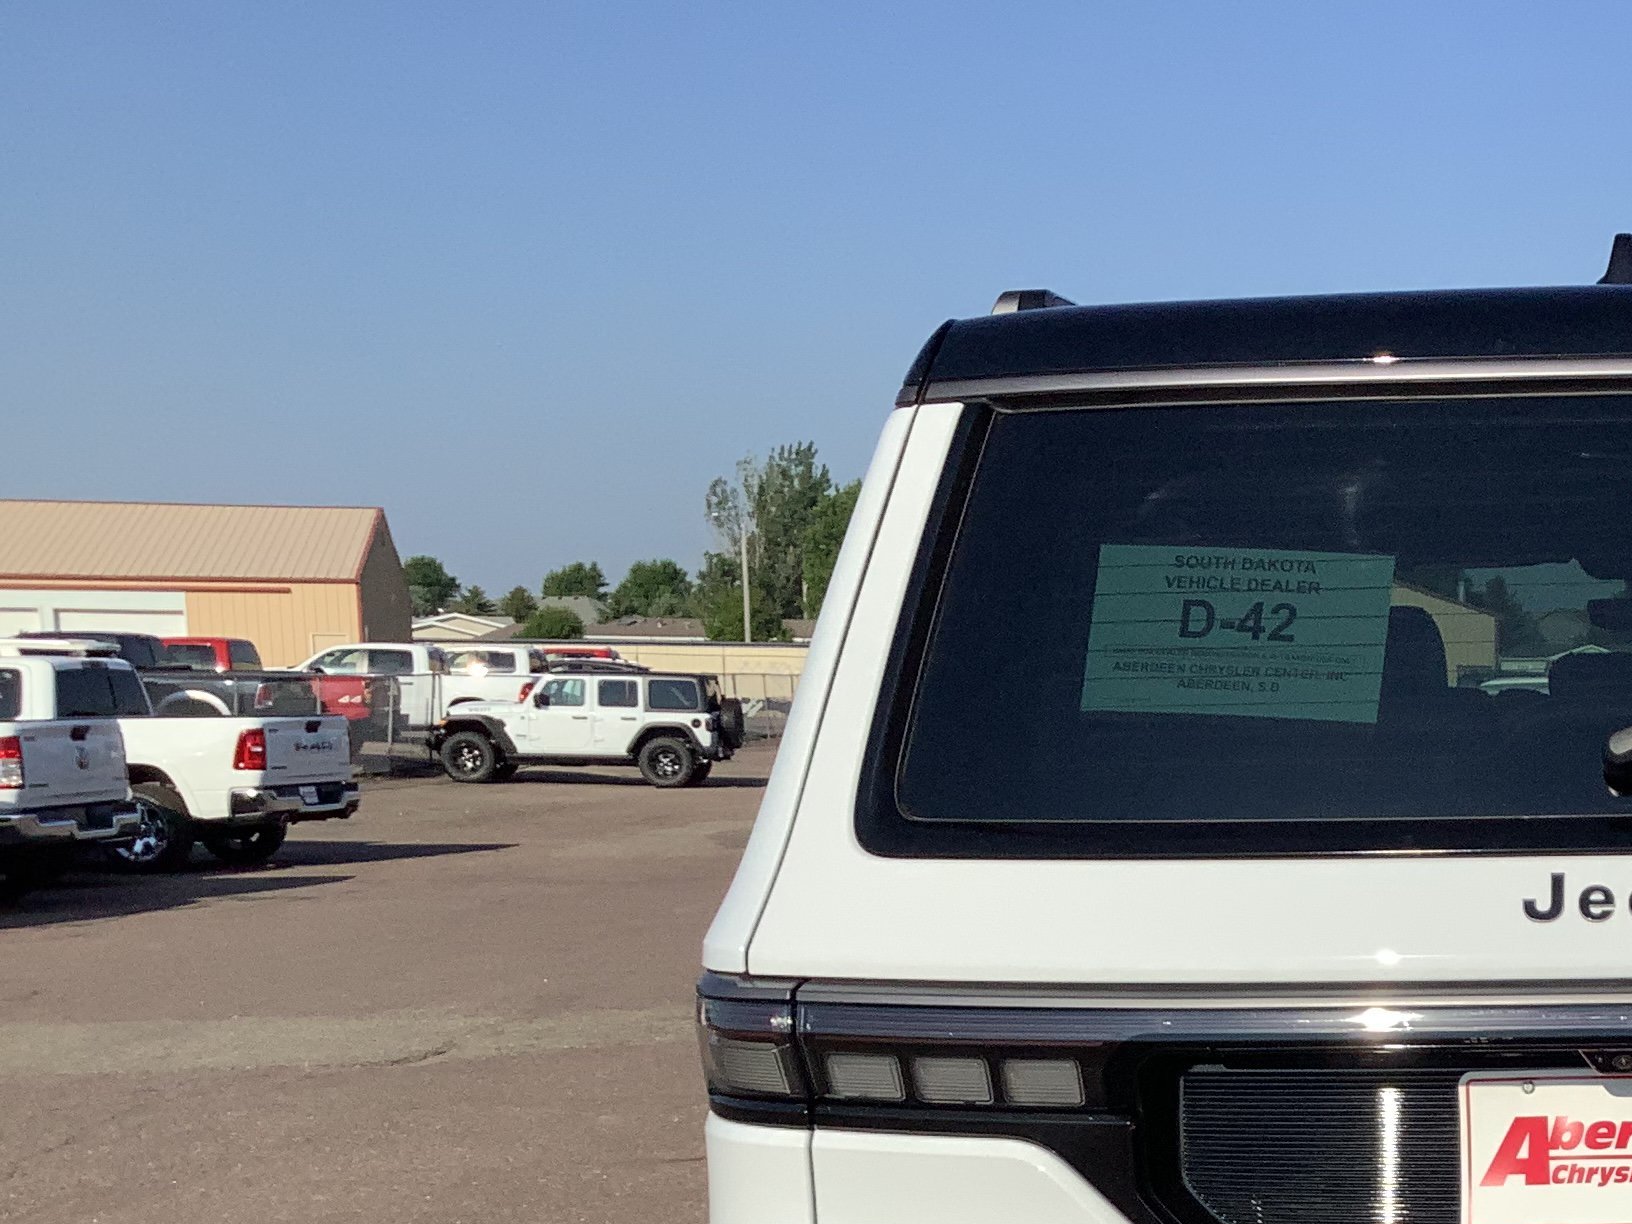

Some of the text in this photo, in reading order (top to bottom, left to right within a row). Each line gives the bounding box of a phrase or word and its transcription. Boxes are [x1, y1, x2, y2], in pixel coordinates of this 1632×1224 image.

[1173, 554, 1317, 574] SOUTH DAKOTA
[1164, 575, 1321, 595] VEHICLE DEALER
[1178, 599, 1298, 643] D-42
[1112, 660, 1187, 674] ABERDEEN
[1189, 663, 1261, 678] CHRYSLER
